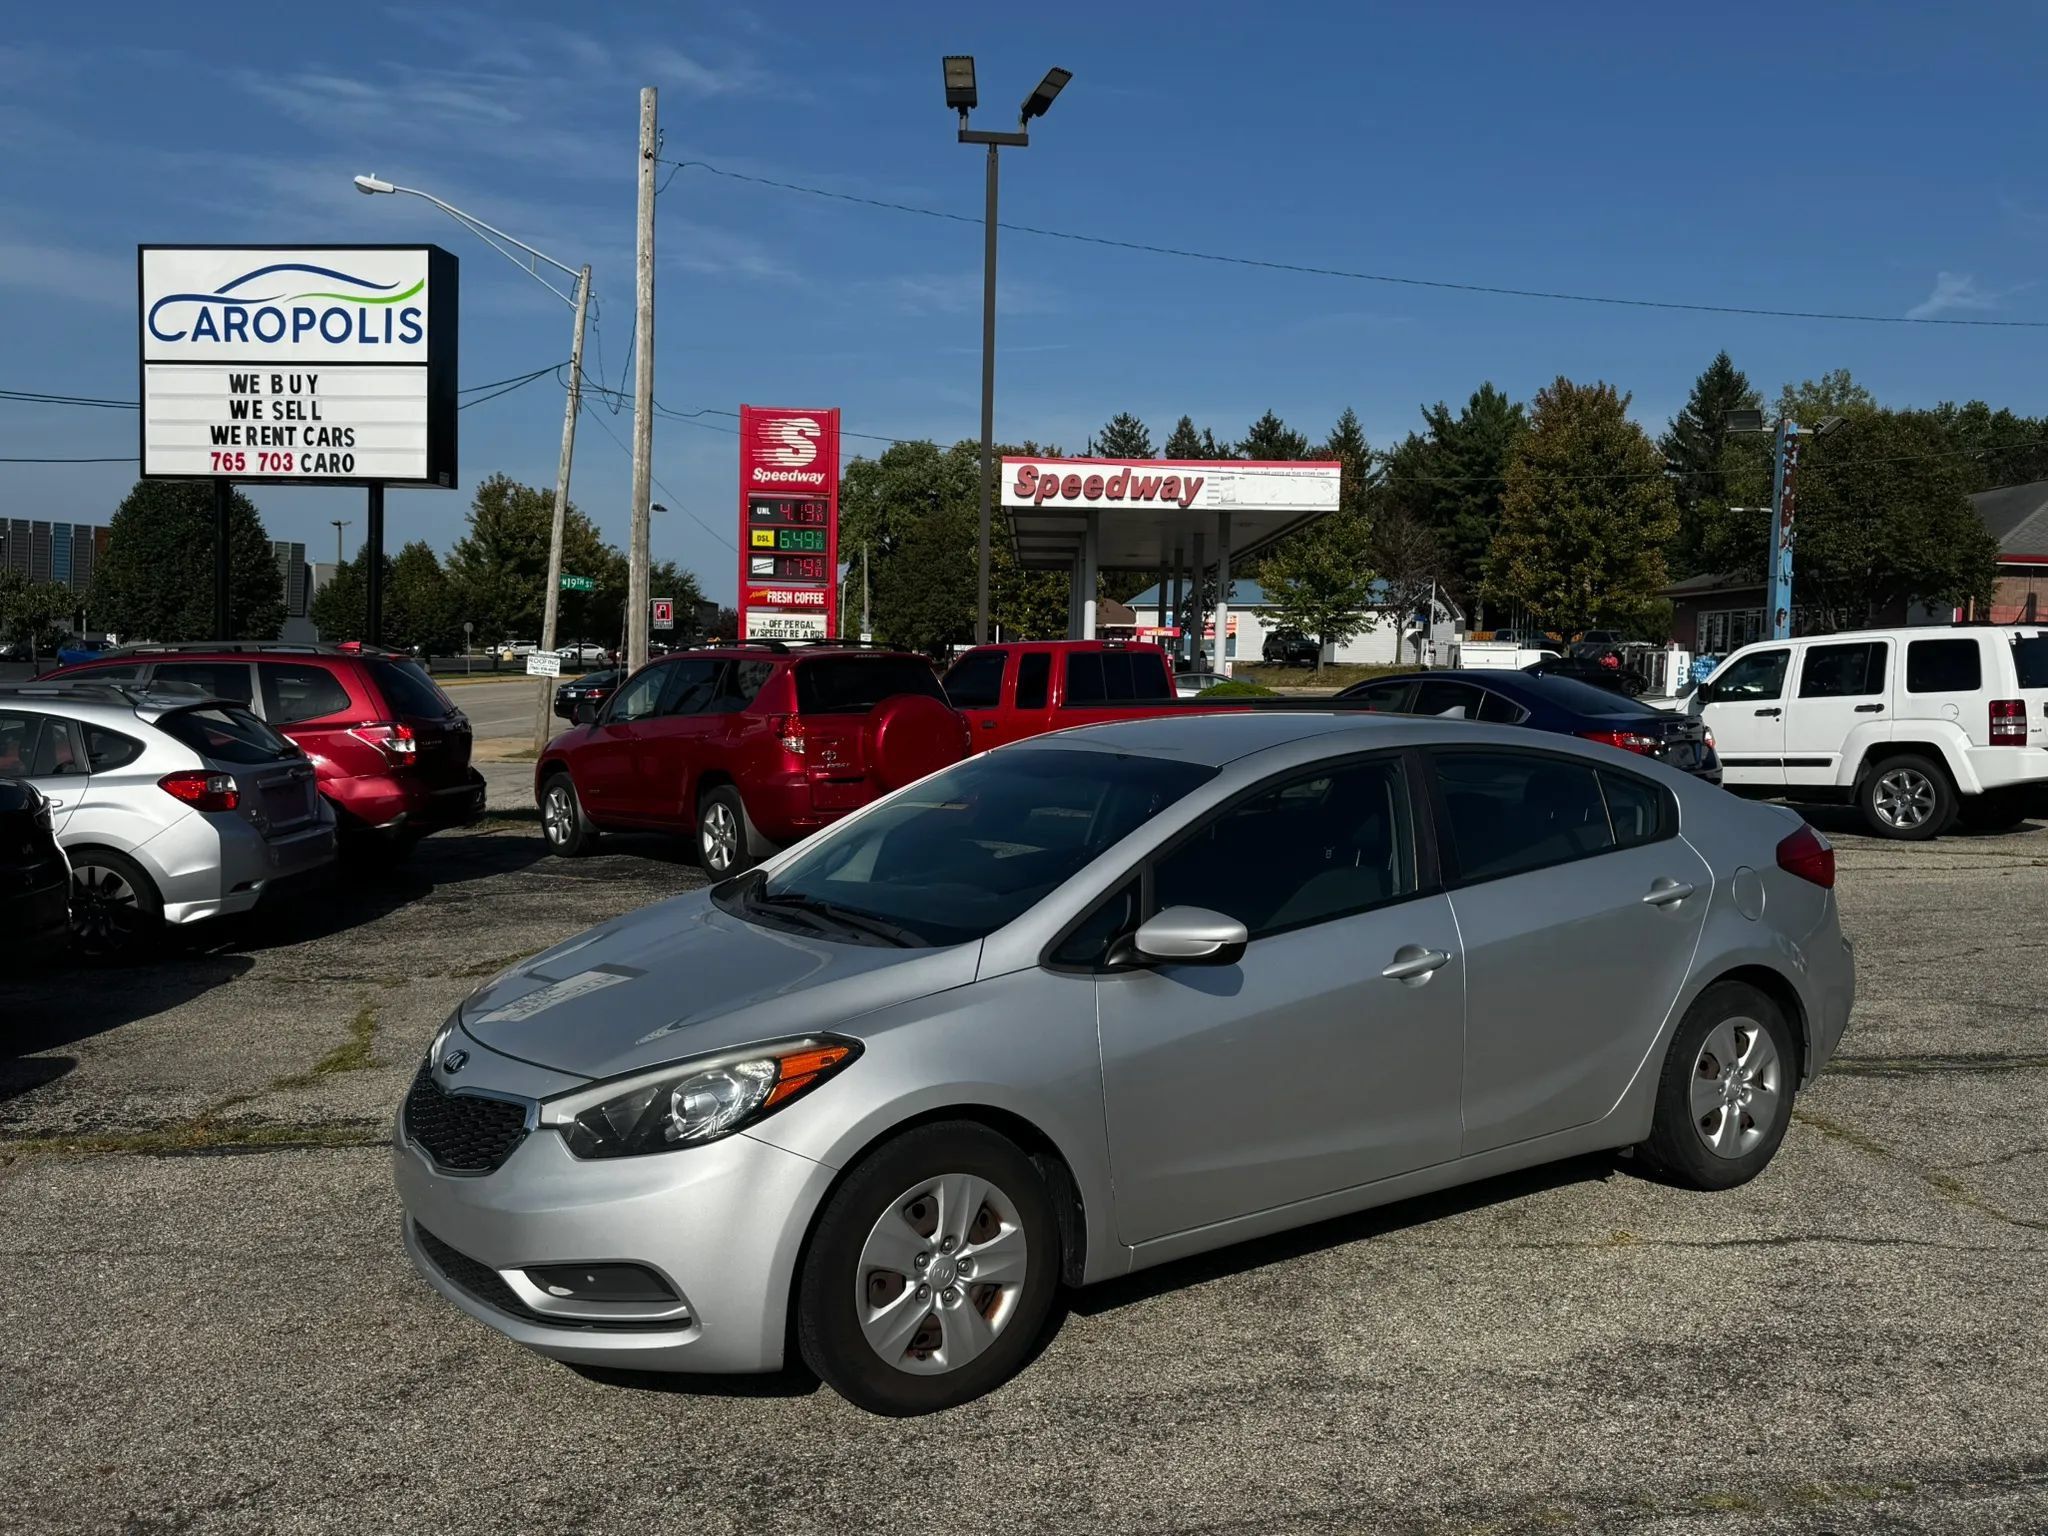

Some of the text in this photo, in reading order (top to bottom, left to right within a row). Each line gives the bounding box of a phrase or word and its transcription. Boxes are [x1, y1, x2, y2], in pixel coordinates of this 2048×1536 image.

[148, 293, 424, 344] CAROPOLIS
[229, 374, 319, 394] WE BUY
[230, 399, 322, 421] WE SELL
[210, 425, 355, 447] WE RENT CARS
[211, 452, 355, 473] 765 703 CARO
[752, 467, 826, 485] Speedway
[1013, 464, 1204, 508] Speedway
[756, 535, 770, 543] DSL
[779, 530, 814, 549] 6.49
[567, 577, 585, 588] 19TH
[585, 580, 593, 588] ST
[767, 590, 793, 603] FRESH
[794, 591, 825, 604] COFFEE
[769, 619, 782, 628] OFF
[528, 656, 559, 666] ROOFING
